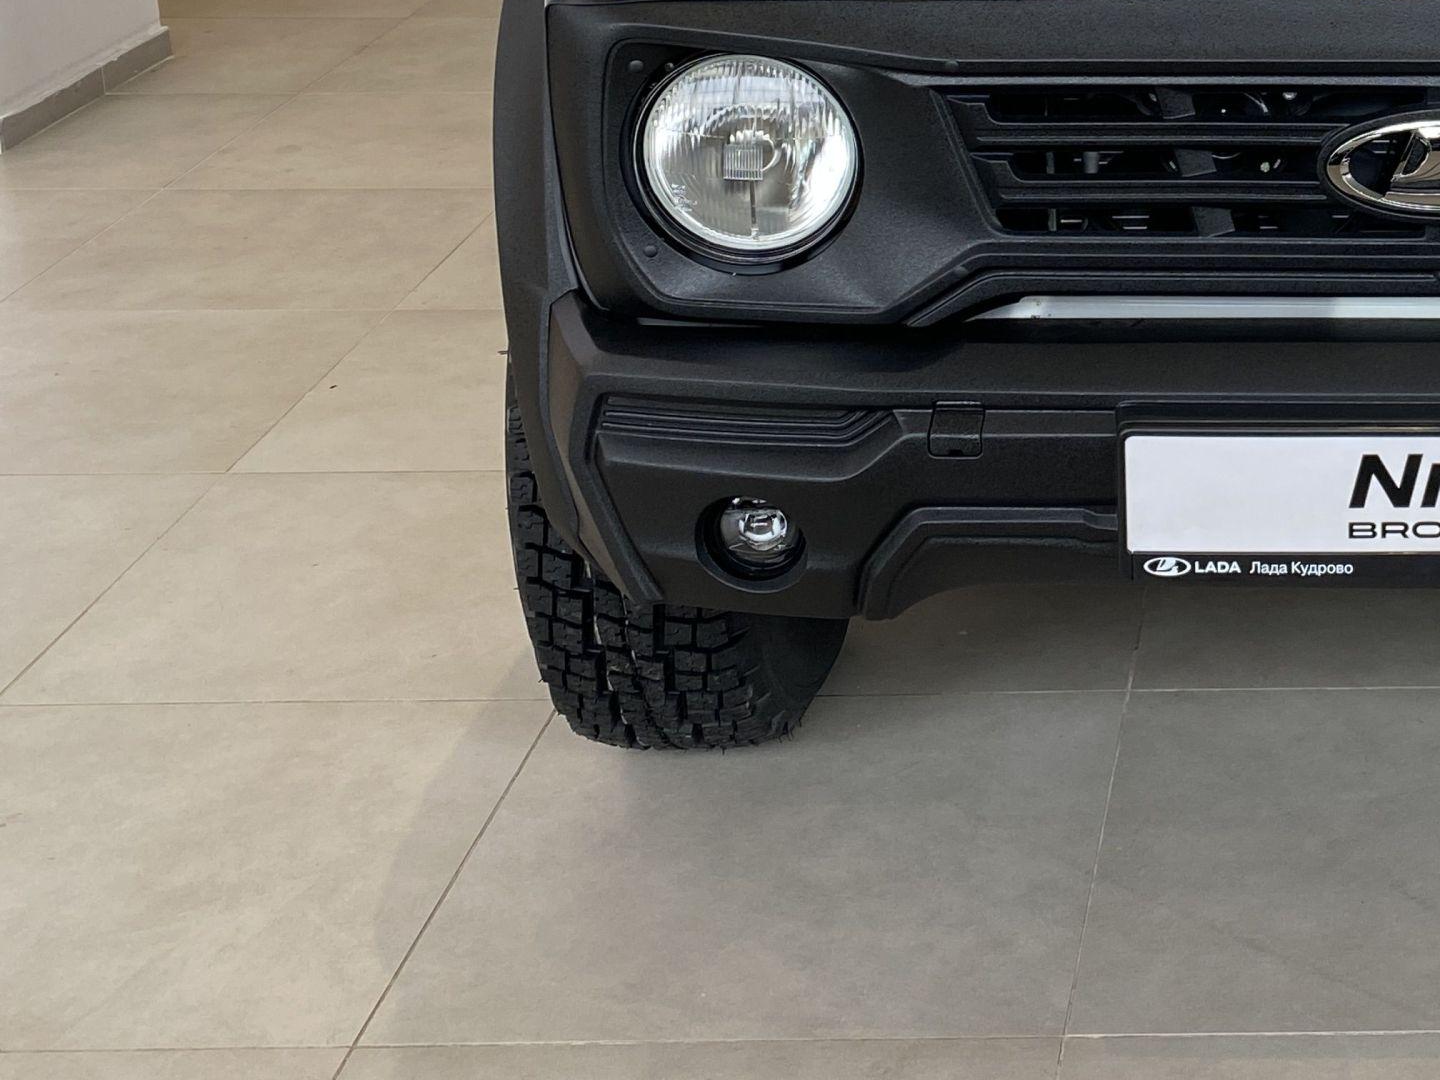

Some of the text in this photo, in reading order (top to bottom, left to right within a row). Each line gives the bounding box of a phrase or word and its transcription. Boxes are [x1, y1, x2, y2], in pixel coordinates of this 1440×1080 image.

[1194, 561, 1355, 577] LADA Лада Кудрово
